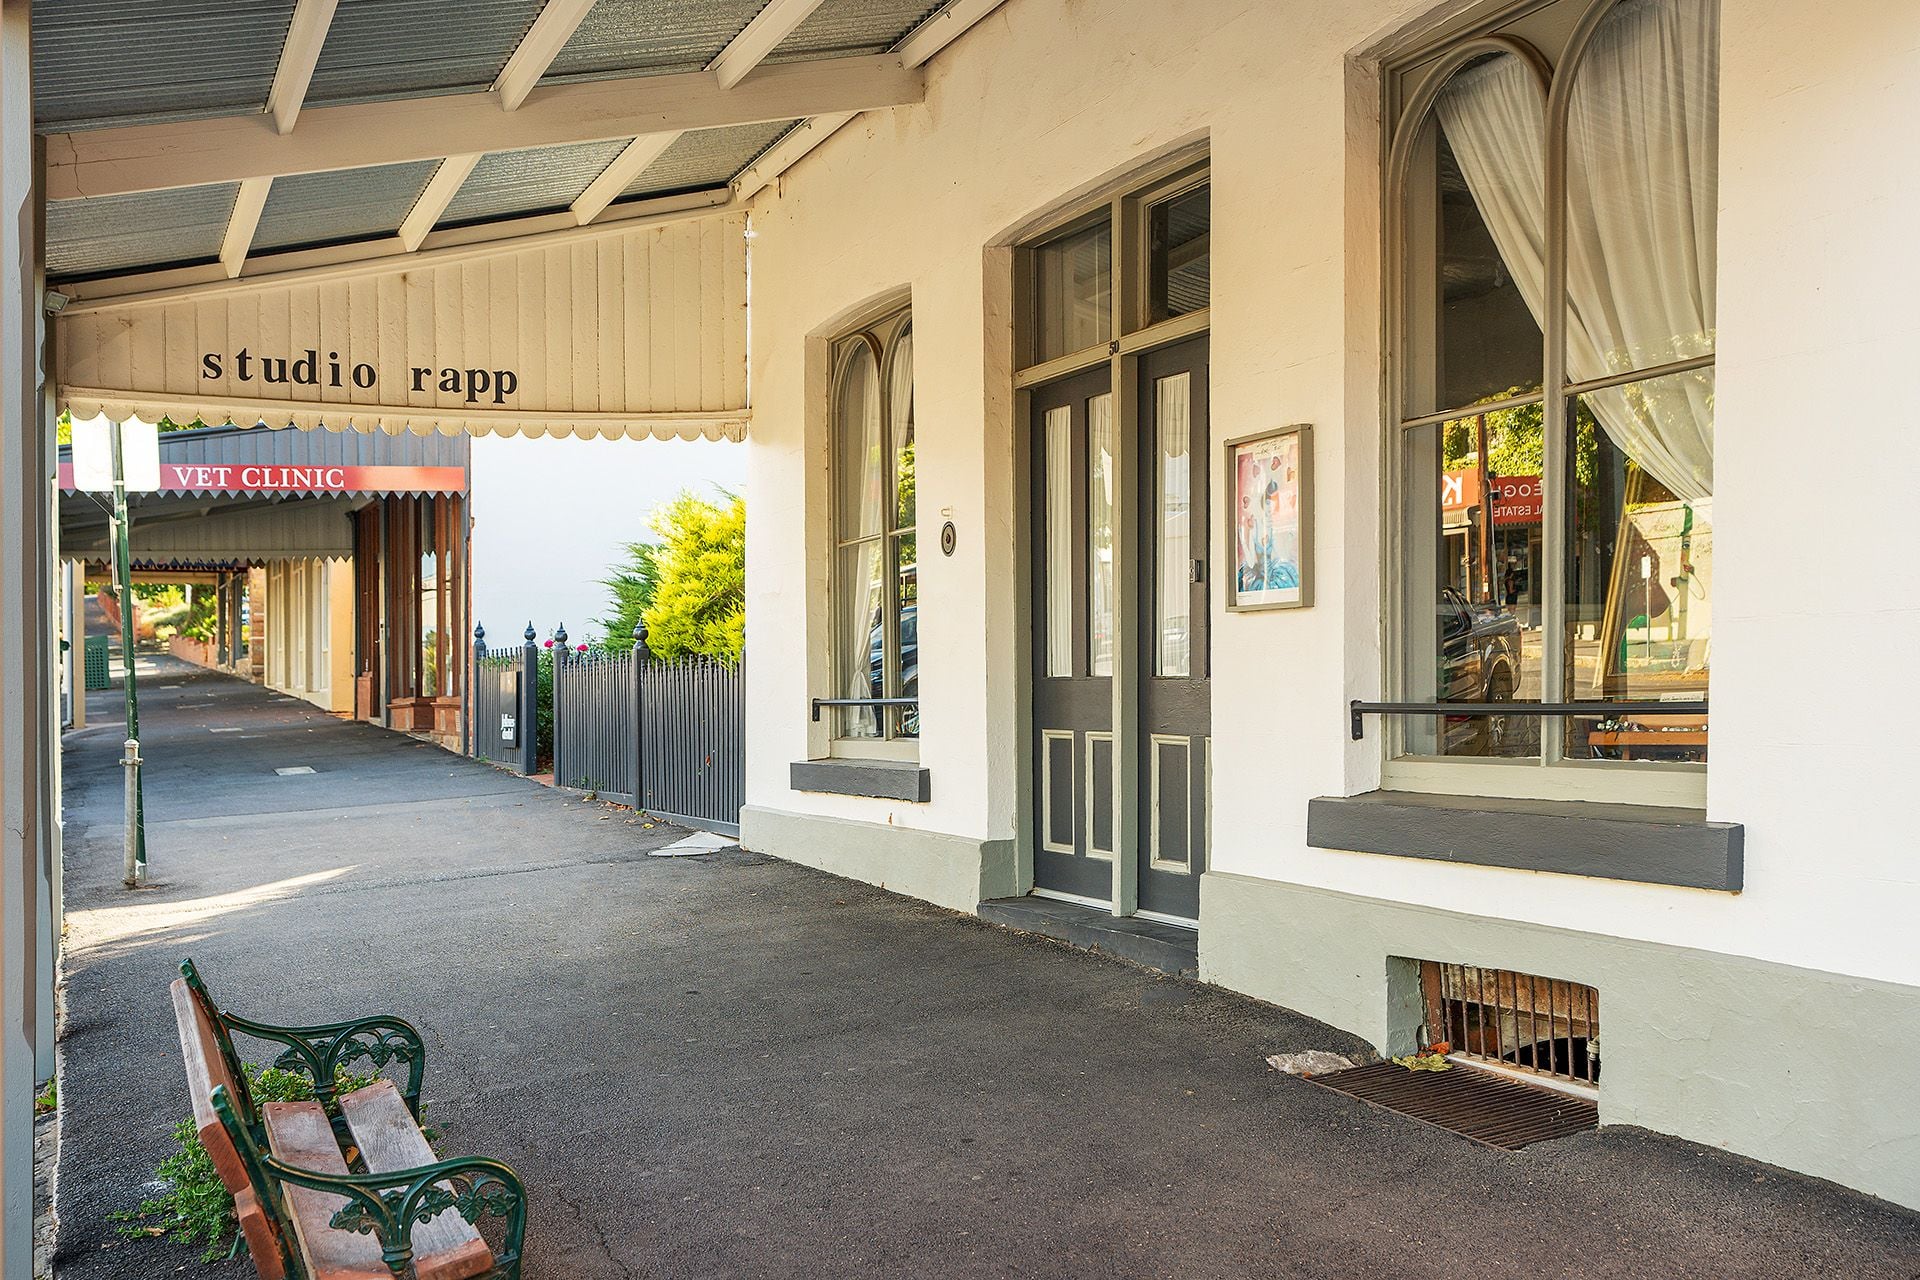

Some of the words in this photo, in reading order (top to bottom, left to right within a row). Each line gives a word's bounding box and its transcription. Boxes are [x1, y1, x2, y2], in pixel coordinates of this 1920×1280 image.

[1109, 340, 1119, 356] 50
[202, 347, 377, 389] studio
[411, 366, 518, 404] rapp
[172, 466, 232, 487] VET
[241, 467, 345, 488] CLINIC
